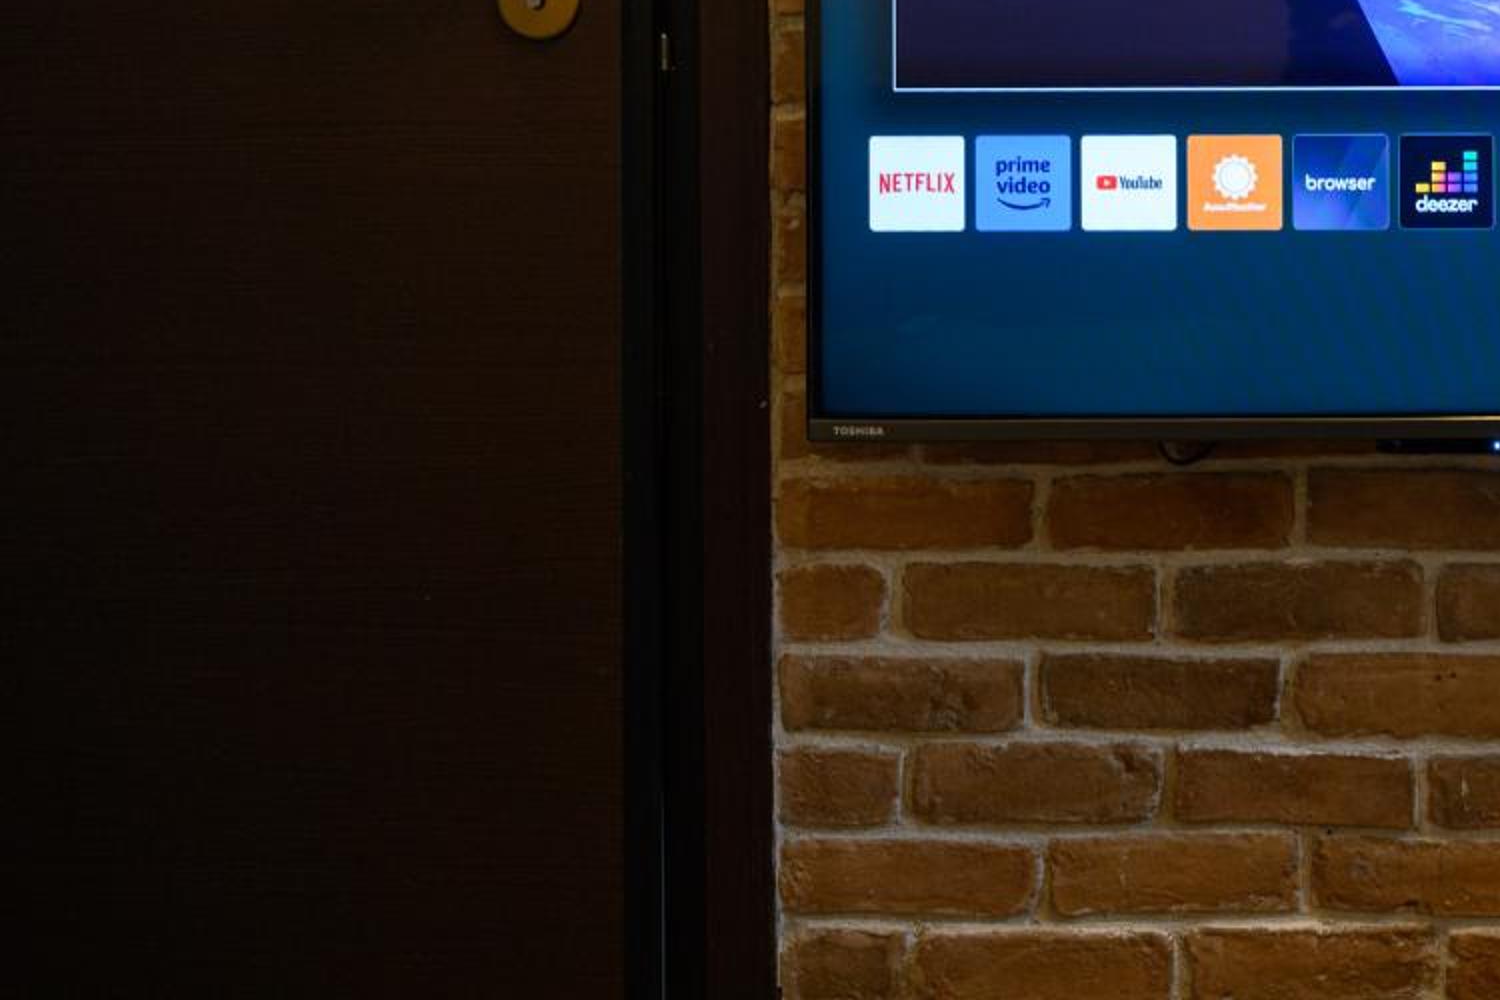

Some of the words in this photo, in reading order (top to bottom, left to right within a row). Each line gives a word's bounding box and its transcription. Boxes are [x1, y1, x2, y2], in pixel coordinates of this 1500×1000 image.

[995, 156, 1051, 177] prime
[879, 173, 955, 194] NETFLIX
[996, 177, 1051, 195] video
[1119, 175, 1163, 190] YouTube
[1305, 173, 1377, 192] browser
[1415, 194, 1479, 213] deezer
